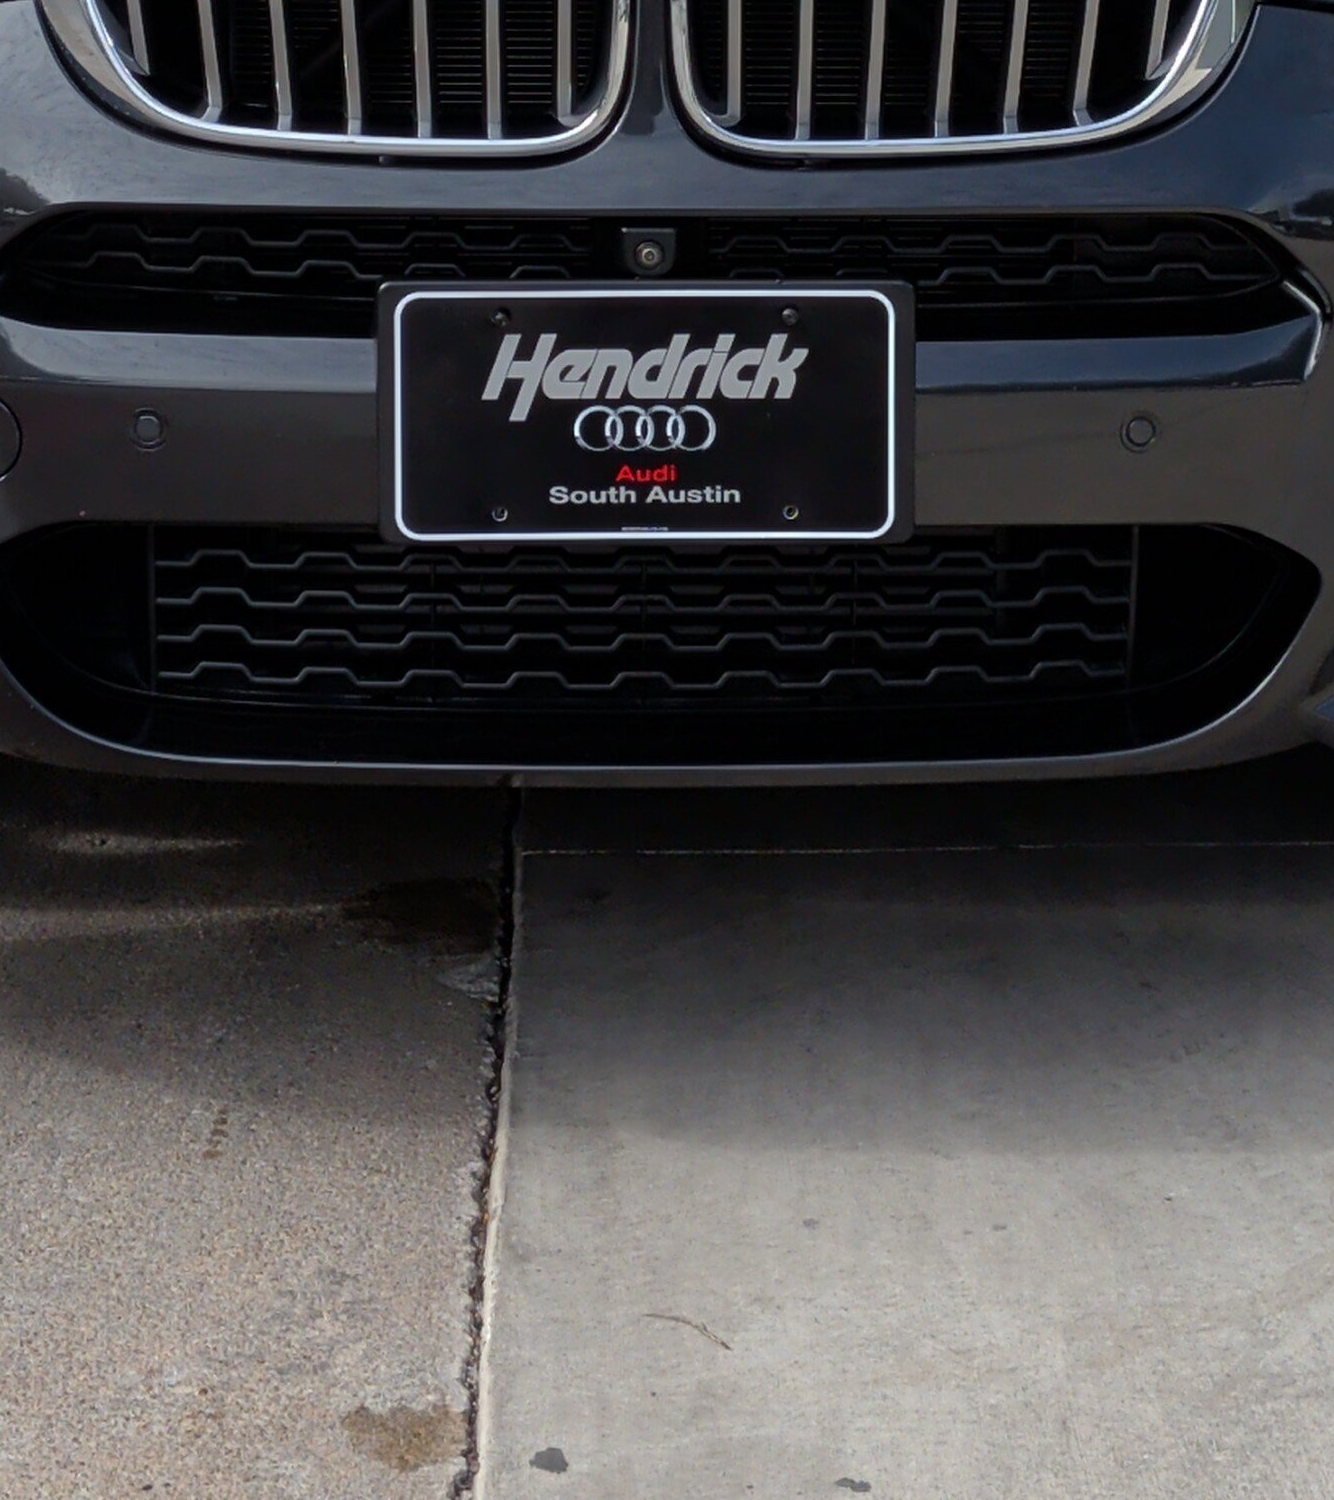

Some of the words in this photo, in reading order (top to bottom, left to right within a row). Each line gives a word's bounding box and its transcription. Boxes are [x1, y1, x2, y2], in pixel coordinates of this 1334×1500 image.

[480, 332, 809, 423] Hendrick
[615, 465, 678, 483] Audi
[549, 486, 637, 505] South
[646, 486, 741, 505] Austin
